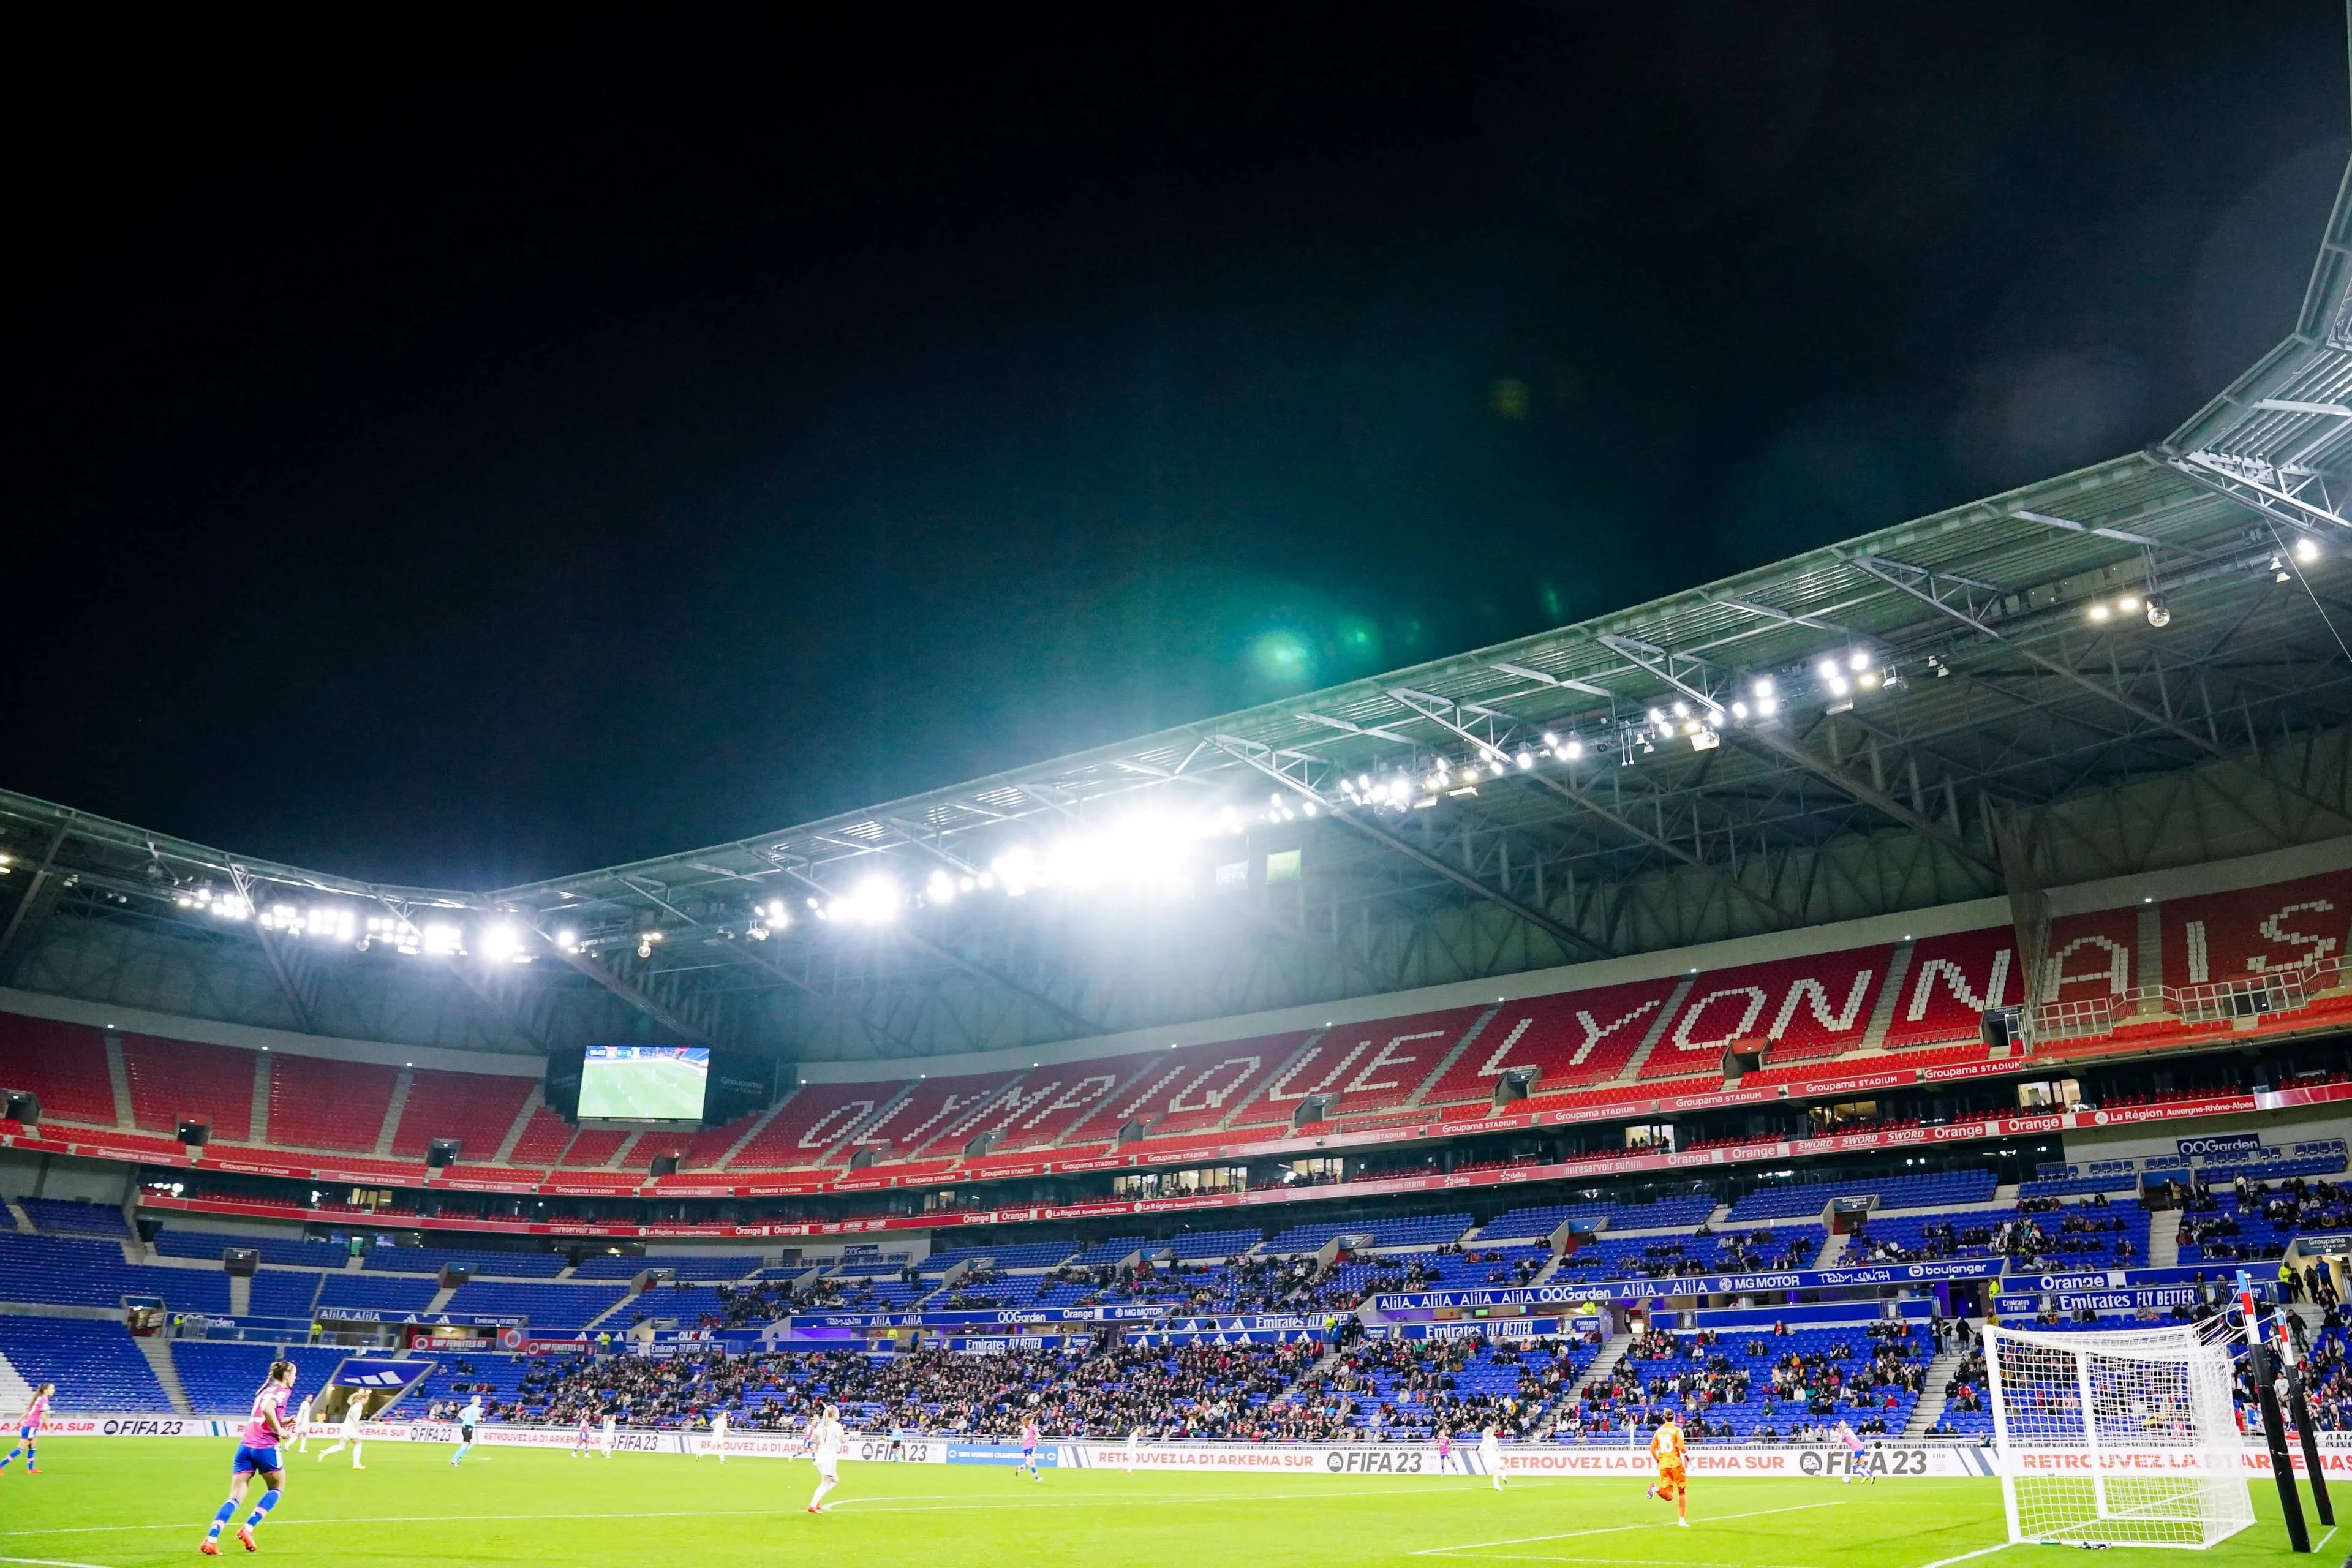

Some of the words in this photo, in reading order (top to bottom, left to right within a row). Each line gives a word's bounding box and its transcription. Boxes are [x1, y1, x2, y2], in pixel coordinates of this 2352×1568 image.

[798, 1030, 1444, 1148] OLYMPIQUE
[1477, 899, 2334, 1077] LYONNAIS
[1925, 1066, 1978, 1079] Groupama
[1980, 1061, 2021, 1072] STADIUM
[1806, 1080, 1856, 1093] Groupama
[1858, 1076, 1898, 1087] STADIUM
[1676, 1096, 1724, 1107] Groupama
[1725, 1092, 1762, 1102] STADIUM
[1556, 1109, 1599, 1121] Groupama
[1602, 1107, 1635, 1116] STADIUM
[2111, 1113, 2124, 1121] La
[2125, 1108, 2163, 1121] Région
[2166, 1101, 2255, 1116] Auvergne-Rhône-Alpes
[1442, 1123, 1483, 1133] Groupama
[1485, 1120, 1517, 1129] STADIUM
[2009, 1117, 2059, 1132] Orange
[1887, 1129, 1924, 1140] SWORD
[1934, 1125, 1983, 1139] Orange
[1798, 1139, 1833, 1150] SWORD
[1842, 1135, 1879, 1145] SWORD
[2180, 1139, 2258, 1154] OOGarden
[1148, 1153, 1181, 1163] Groupama
[1668, 1153, 1709, 1165] Orange
[1732, 1147, 1775, 1159] Orange
[1062, 1161, 1093, 1170] Groupama
[981, 1169, 1010, 1178] Groupama
[963, 1214, 989, 1224] Orange
[1001, 1212, 1028, 1221] Orange
[736, 1227, 761, 1235] Orange
[774, 1226, 800, 1234] Orange
[2308, 1238, 2345, 1246] Groupama
[1924, 1264, 1987, 1276] boulanger
[1735, 1278, 1754, 1289] MG
[1756, 1276, 1800, 1288] MOTOR
[2041, 1276, 2105, 1290] Orange
[1540, 1287, 1611, 1302] OOGarden
[2060, 1294, 2130, 1310] Emirates
[2137, 1291, 2155, 1306] FLY
[2157, 1289, 2195, 1305] BETTER
[998, 1312, 1046, 1322] OOGarden
[1063, 1309, 1093, 1319] Orange
[1137, 1307, 1163, 1316] MOTOR
[1256, 1316, 1304, 1327] Emirates
[1425, 1324, 1482, 1339] Emirates
[1487, 1323, 1501, 1335] FLY
[1502, 1321, 1533, 1335] BETTER
[965, 1339, 1006, 1351] Emirates
[68, 1422, 96, 1431] SUR
[121, 1421, 159, 1434] FIFA
[162, 1421, 183, 1434] 23
[418, 1428, 440, 1441] FIFA
[440, 1428, 451, 1441] 23
[484, 1433, 527, 1442] RETROUVEZ
[617, 1436, 641, 1450] FIFA
[643, 1436, 658, 1450] 23
[756, 1442, 767, 1451] LA
[909, 1444, 927, 1461] 23
[1180, 1453, 1196, 1464] LA
[1200, 1454, 1215, 1464] D1
[1217, 1454, 1281, 1466] ARKEMA
[1284, 1455, 1314, 1466] SUR
[1347, 1452, 1393, 1472] FIFA
[1395, 1452, 1422, 1473] 23
[1607, 1457, 1628, 1469] LA
[1632, 1456, 1652, 1469] D1
[1745, 1455, 1785, 1469] SUR
[1892, 1450, 1927, 1475] 23
